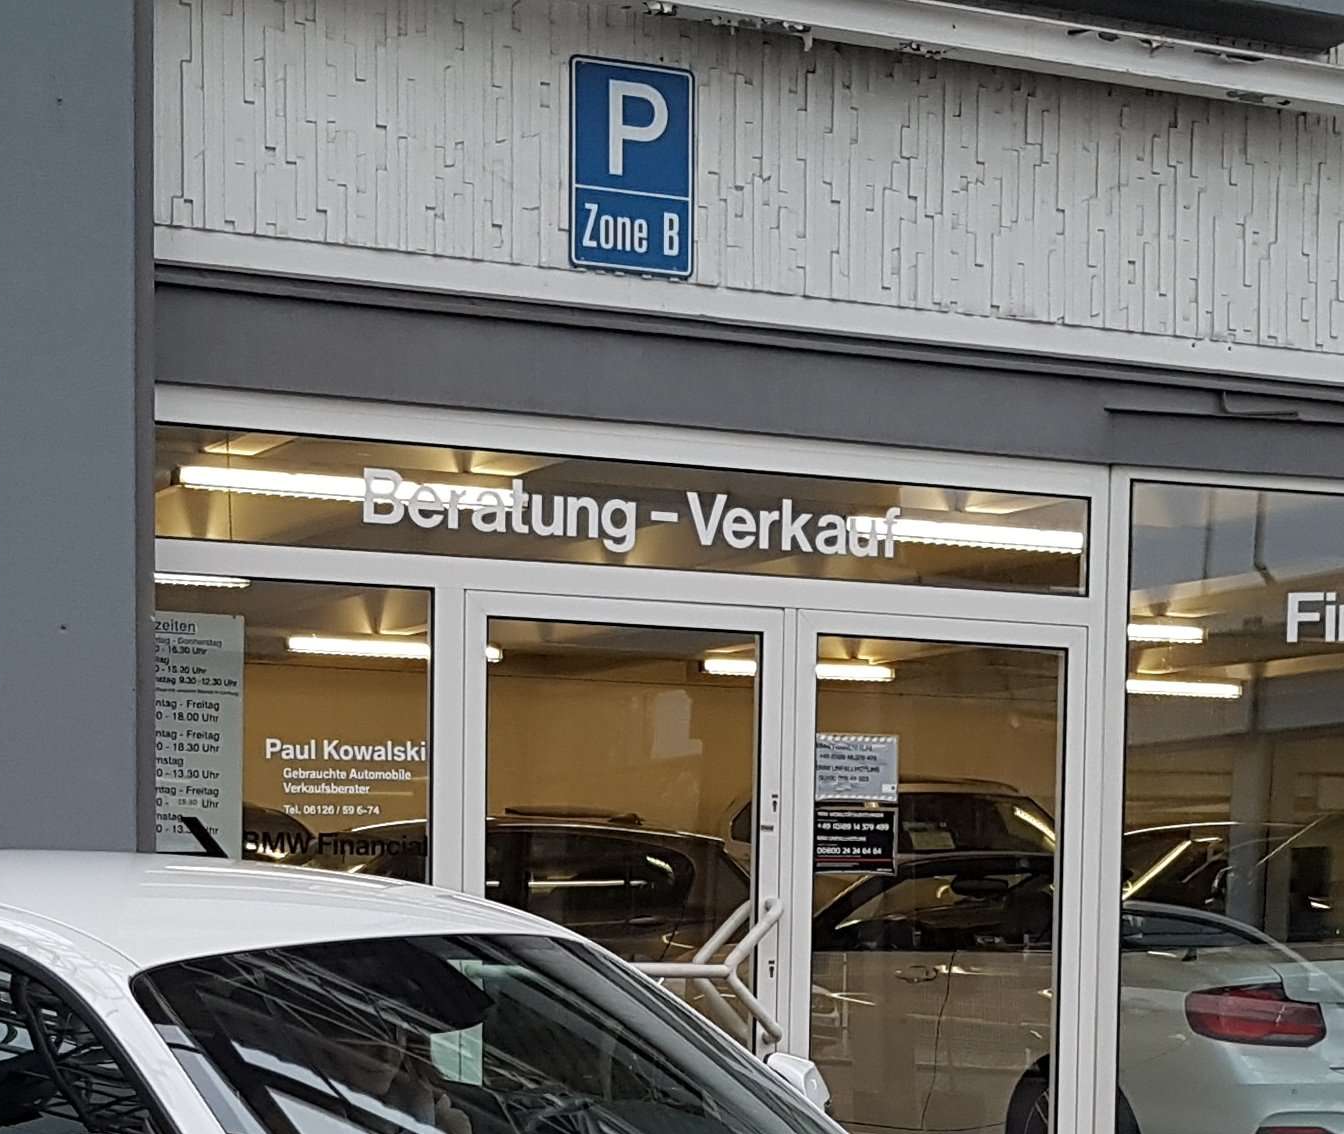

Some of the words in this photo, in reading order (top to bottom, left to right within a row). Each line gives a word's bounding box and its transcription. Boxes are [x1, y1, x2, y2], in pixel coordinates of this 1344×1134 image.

[609, 79, 669, 176] P
[582, 202, 648, 253] Zone
[663, 212, 679, 256] B
[362, 468, 637, 553] Beratung
[686, 491, 901, 558] Verkauf
[186, 699, 220, 711] Freitag
[201, 712, 219, 722] Uhr
[186, 729, 220, 742] Freitag
[202, 743, 220, 752] Uhr
[265, 738, 316, 760] Paul
[323, 739, 426, 762] Kowalski
[201, 769, 220, 779] Uhr
[283, 767, 346, 780] Gebrauchte
[349, 768, 412, 781] Automobile
[186, 785, 220, 798] Freitag
[283, 782, 371, 794] Verkaufsberater
[201, 799, 220, 808] Uhr
[283, 804, 299, 815] Tel.
[244, 831, 316, 855] BMW
[318, 831, 428, 857] Financial
